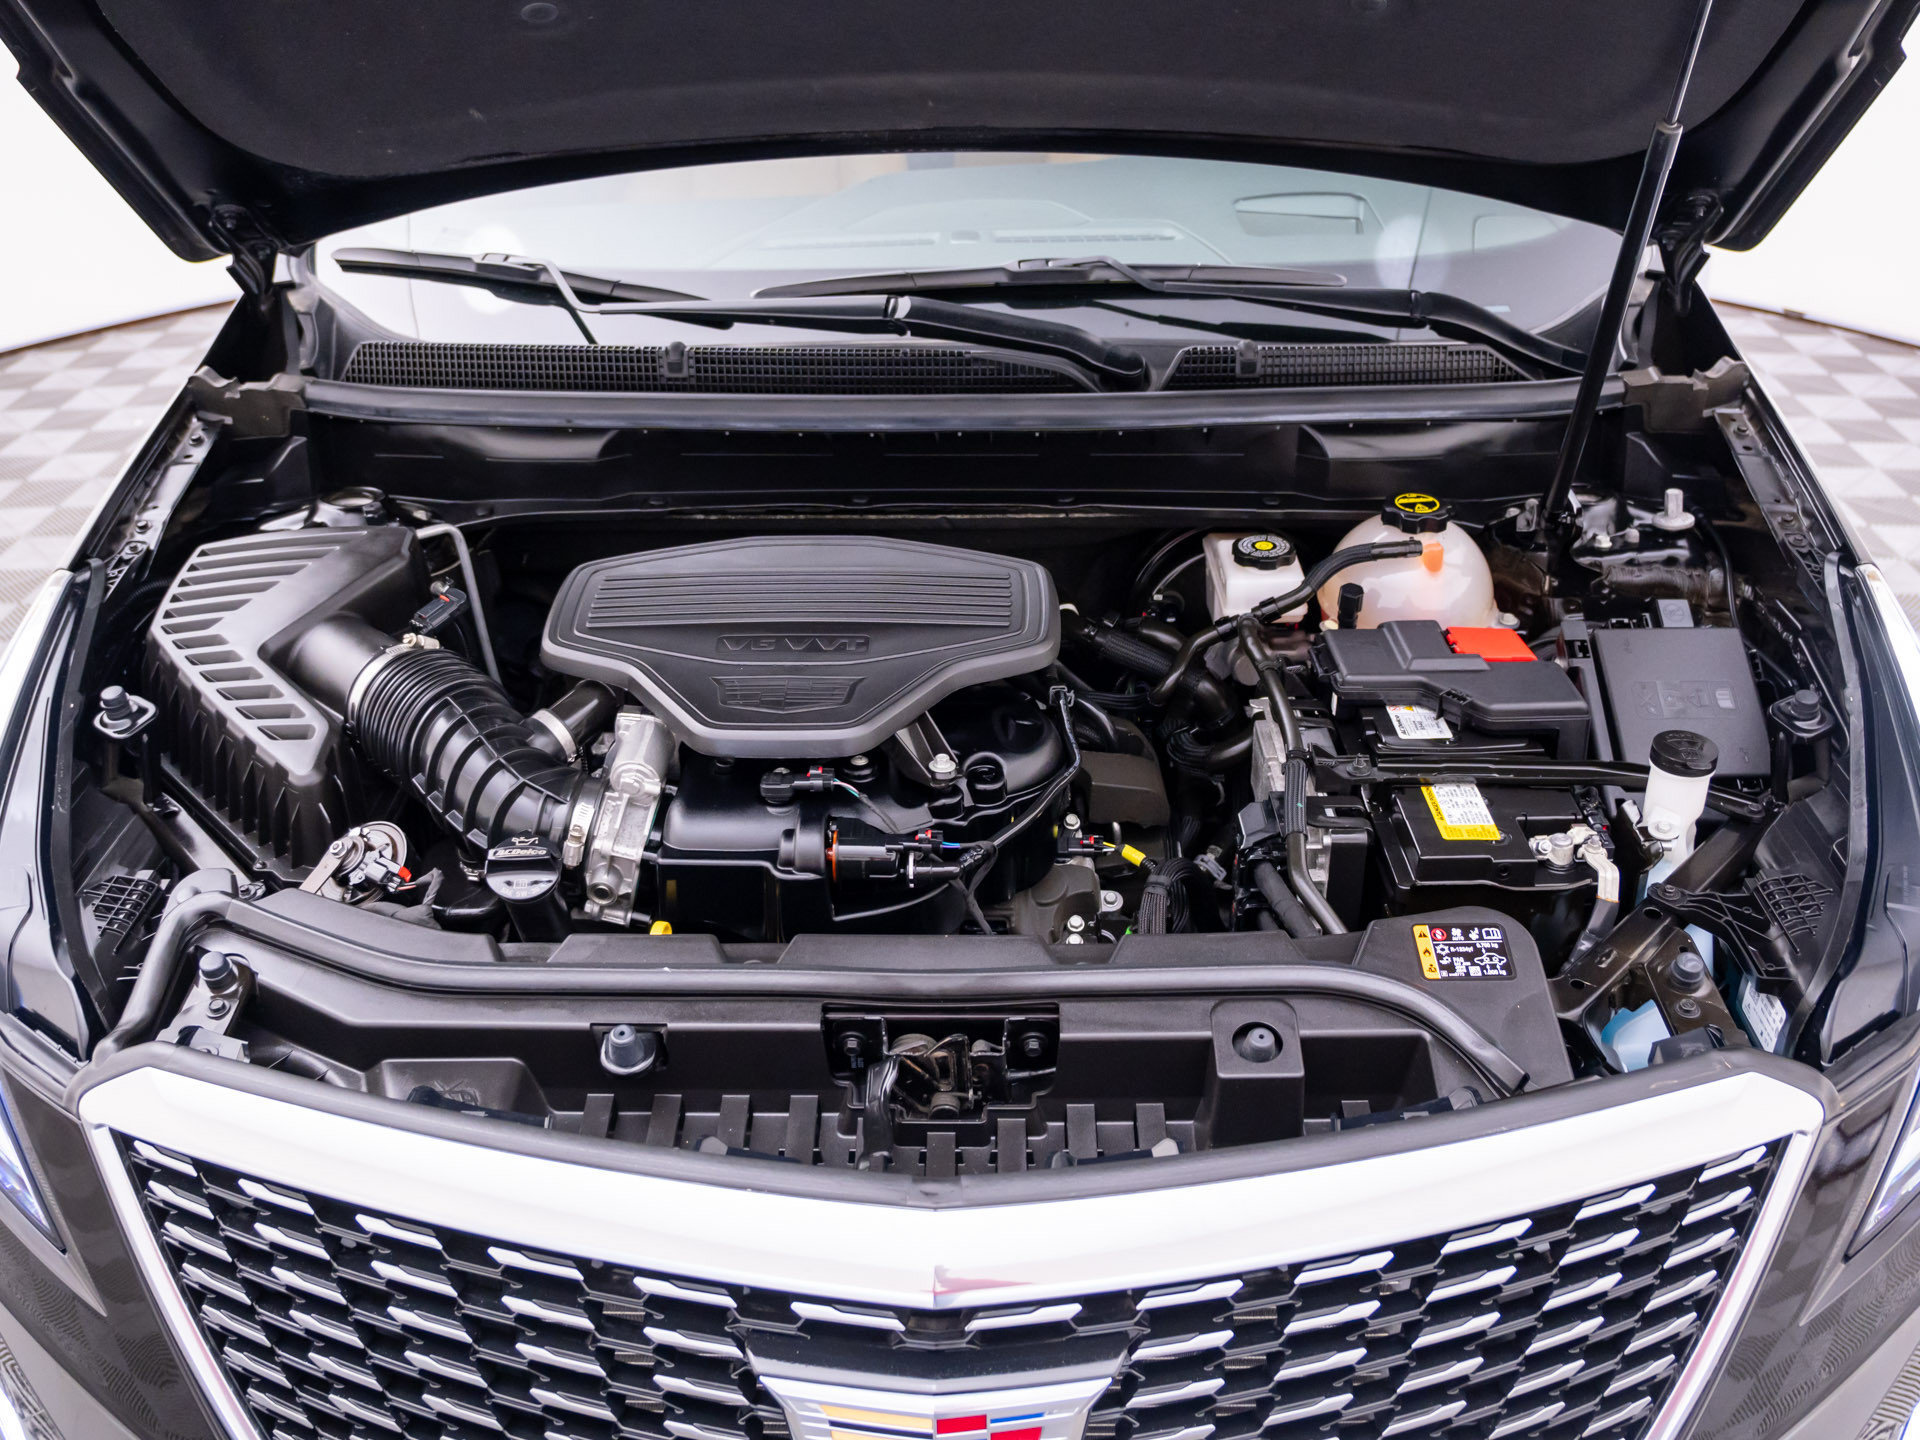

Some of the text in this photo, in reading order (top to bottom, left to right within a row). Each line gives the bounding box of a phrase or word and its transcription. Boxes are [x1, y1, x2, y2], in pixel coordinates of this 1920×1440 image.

[723, 638, 866, 651] V6 VVT
[495, 848, 547, 857] ACDelco
